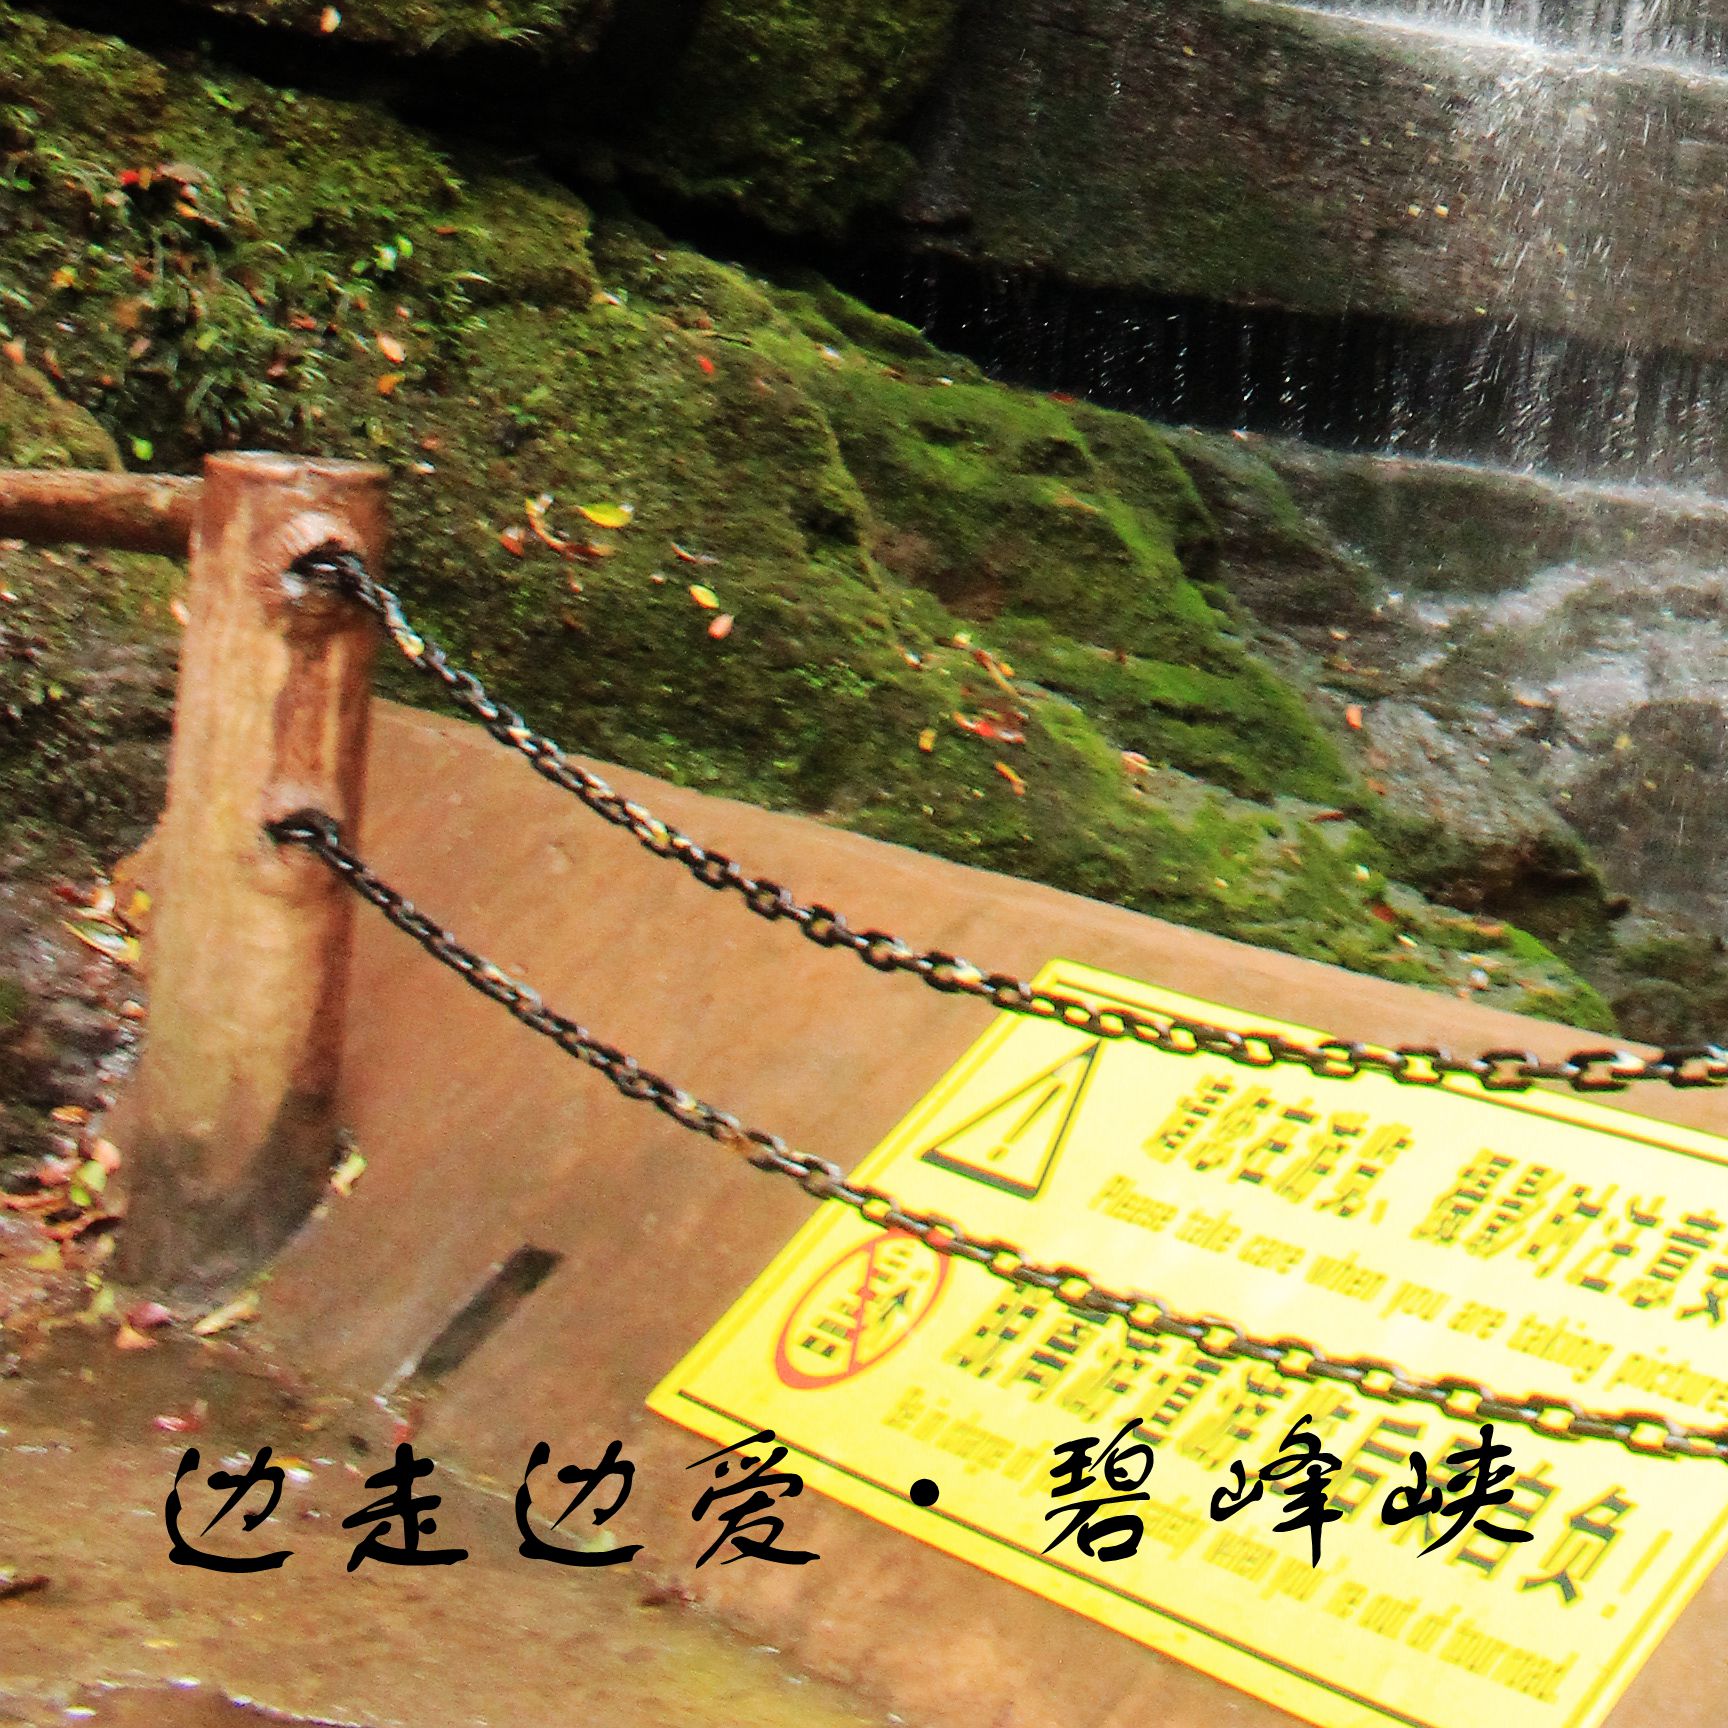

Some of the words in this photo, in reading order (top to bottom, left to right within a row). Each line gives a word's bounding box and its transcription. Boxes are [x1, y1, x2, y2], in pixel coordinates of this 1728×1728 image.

[1087, 1173, 1179, 1233] Please
[1173, 1206, 1243, 1254] take
[1236, 1233, 1306, 1275] care
[1304, 1250, 1389, 1302] when
[1378, 1280, 1451, 1322] you
[1446, 1299, 1508, 1341] are
[1505, 1312, 1614, 1381] taking
